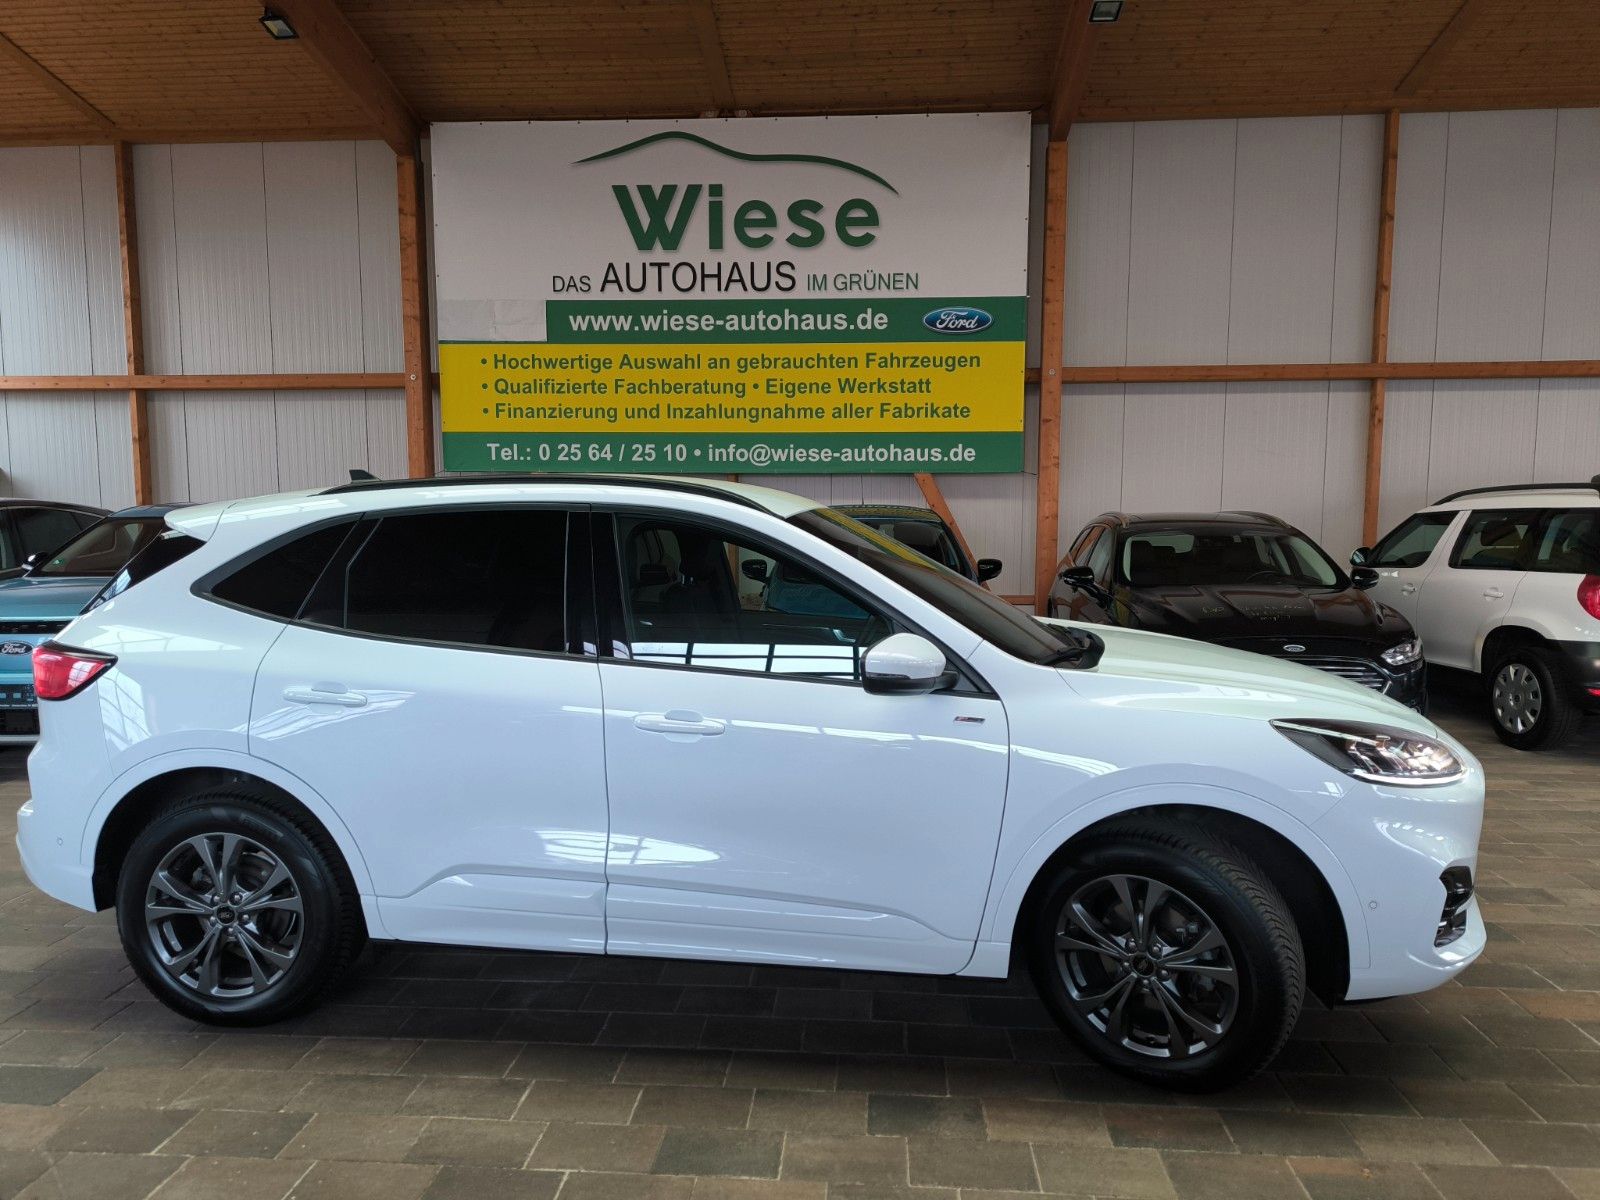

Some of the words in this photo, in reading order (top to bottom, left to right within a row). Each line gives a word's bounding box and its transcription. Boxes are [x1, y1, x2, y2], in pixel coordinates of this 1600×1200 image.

[611, 183, 881, 253] Wiese
[552, 274, 592, 294] DAS
[600, 260, 797, 294] AUTOHAUS
[807, 273, 829, 291] IM
[833, 270, 919, 292] GRÜNEN
[569, 307, 888, 332] www.wiese-autohaus.de
[936, 311, 979, 328] Ford
[493, 353, 613, 374] Hochwertige
[618, 353, 701, 370] Auswahl
[707, 357, 731, 370] an
[736, 353, 859, 374] gebrauchten
[865, 352, 981, 373] Fahrzeugen
[493, 377, 608, 396] Qualifizierte
[614, 377, 746, 398] Fachberatung
[765, 377, 832, 398] Eigene
[837, 377, 932, 394] Werkstatt
[495, 403, 618, 423] Finanzierung
[624, 403, 660, 419] und
[666, 403, 826, 423] Inzahlungnahme
[831, 403, 874, 418] aller
[880, 402, 971, 418] Fabrikate
[486, 443, 531, 461] Tel.:
[538, 443, 551, 461] 0
[557, 443, 582, 461] 25
[588, 443, 613, 461] 64
[618, 444, 625, 462] /
[631, 443, 656, 462] 25
[663, 443, 687, 462] 10
[708, 443, 977, 467] info@wiese-autohaus.de
